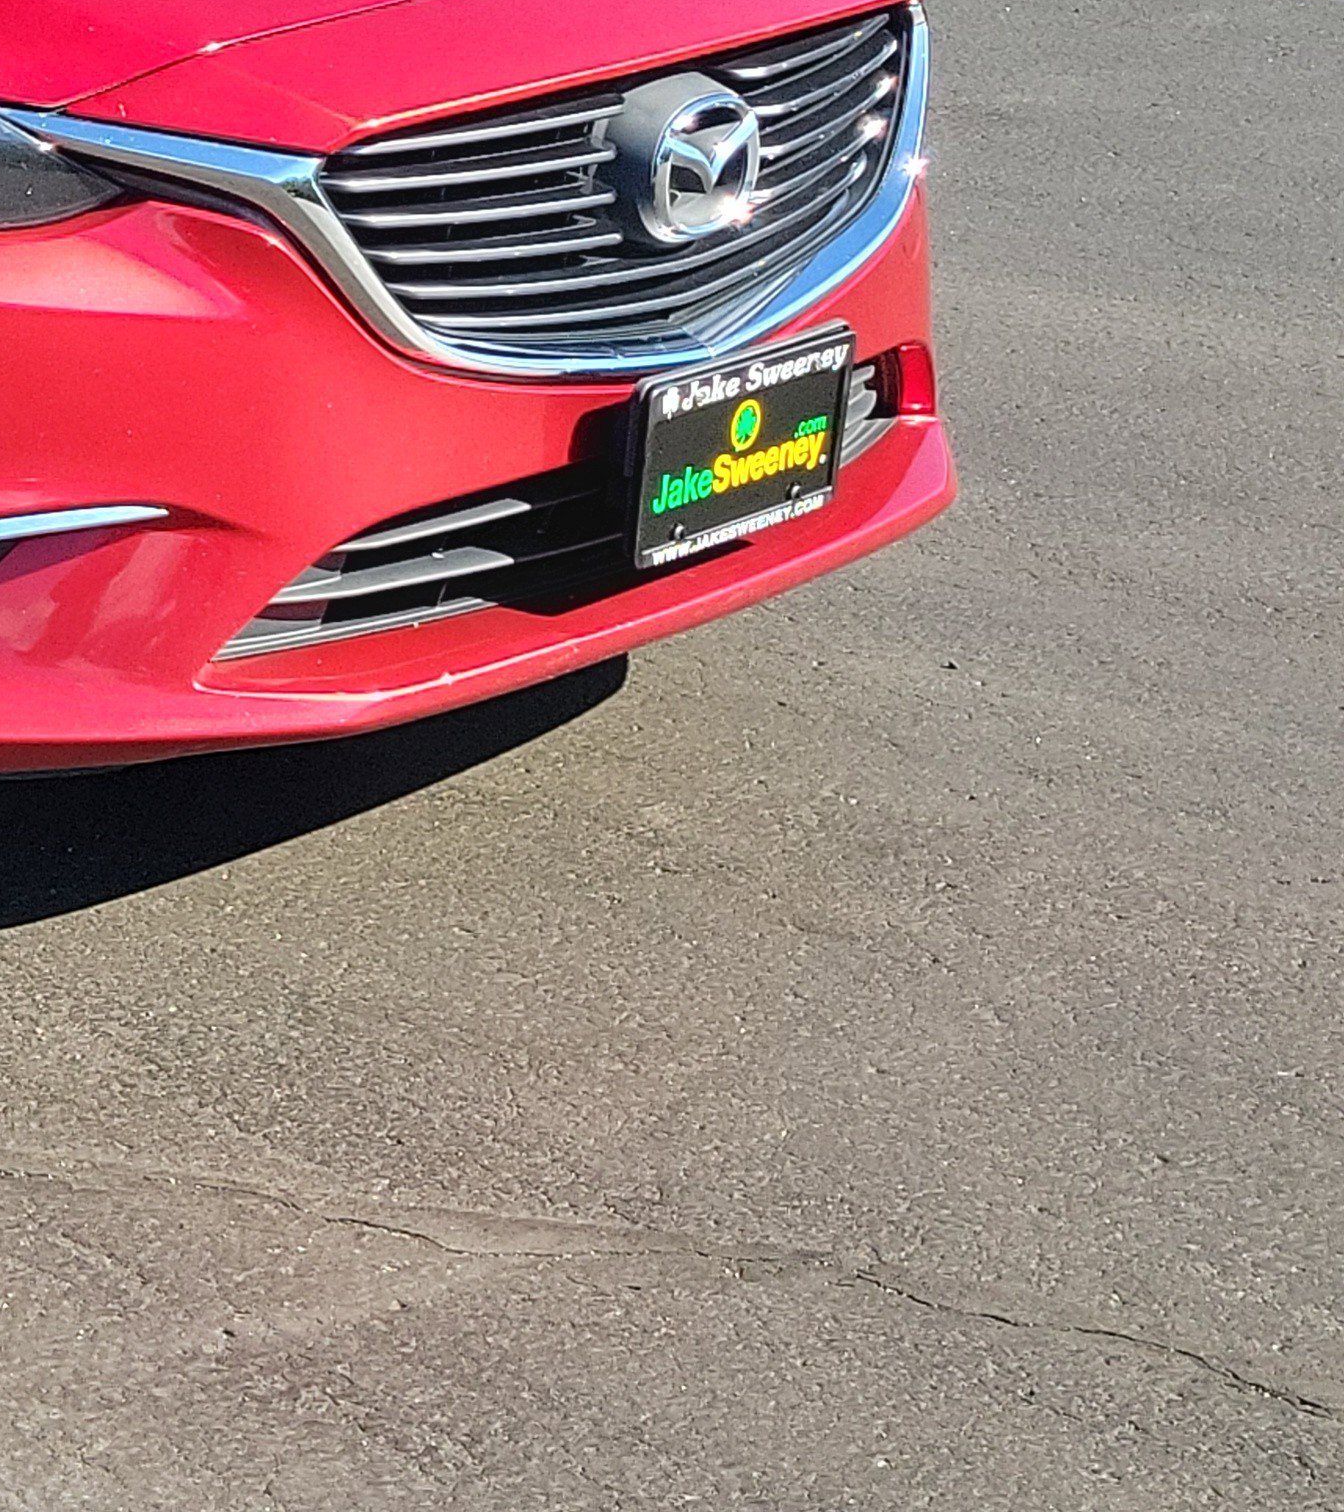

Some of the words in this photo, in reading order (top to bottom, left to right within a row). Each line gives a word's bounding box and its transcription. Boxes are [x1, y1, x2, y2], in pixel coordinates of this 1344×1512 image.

[682, 374, 742, 412] Jake
[745, 343, 851, 391] Sweeney
[652, 431, 826, 515] JakeSweeney
[651, 494, 825, 566] WWW.JAKESWEENEY.COM
